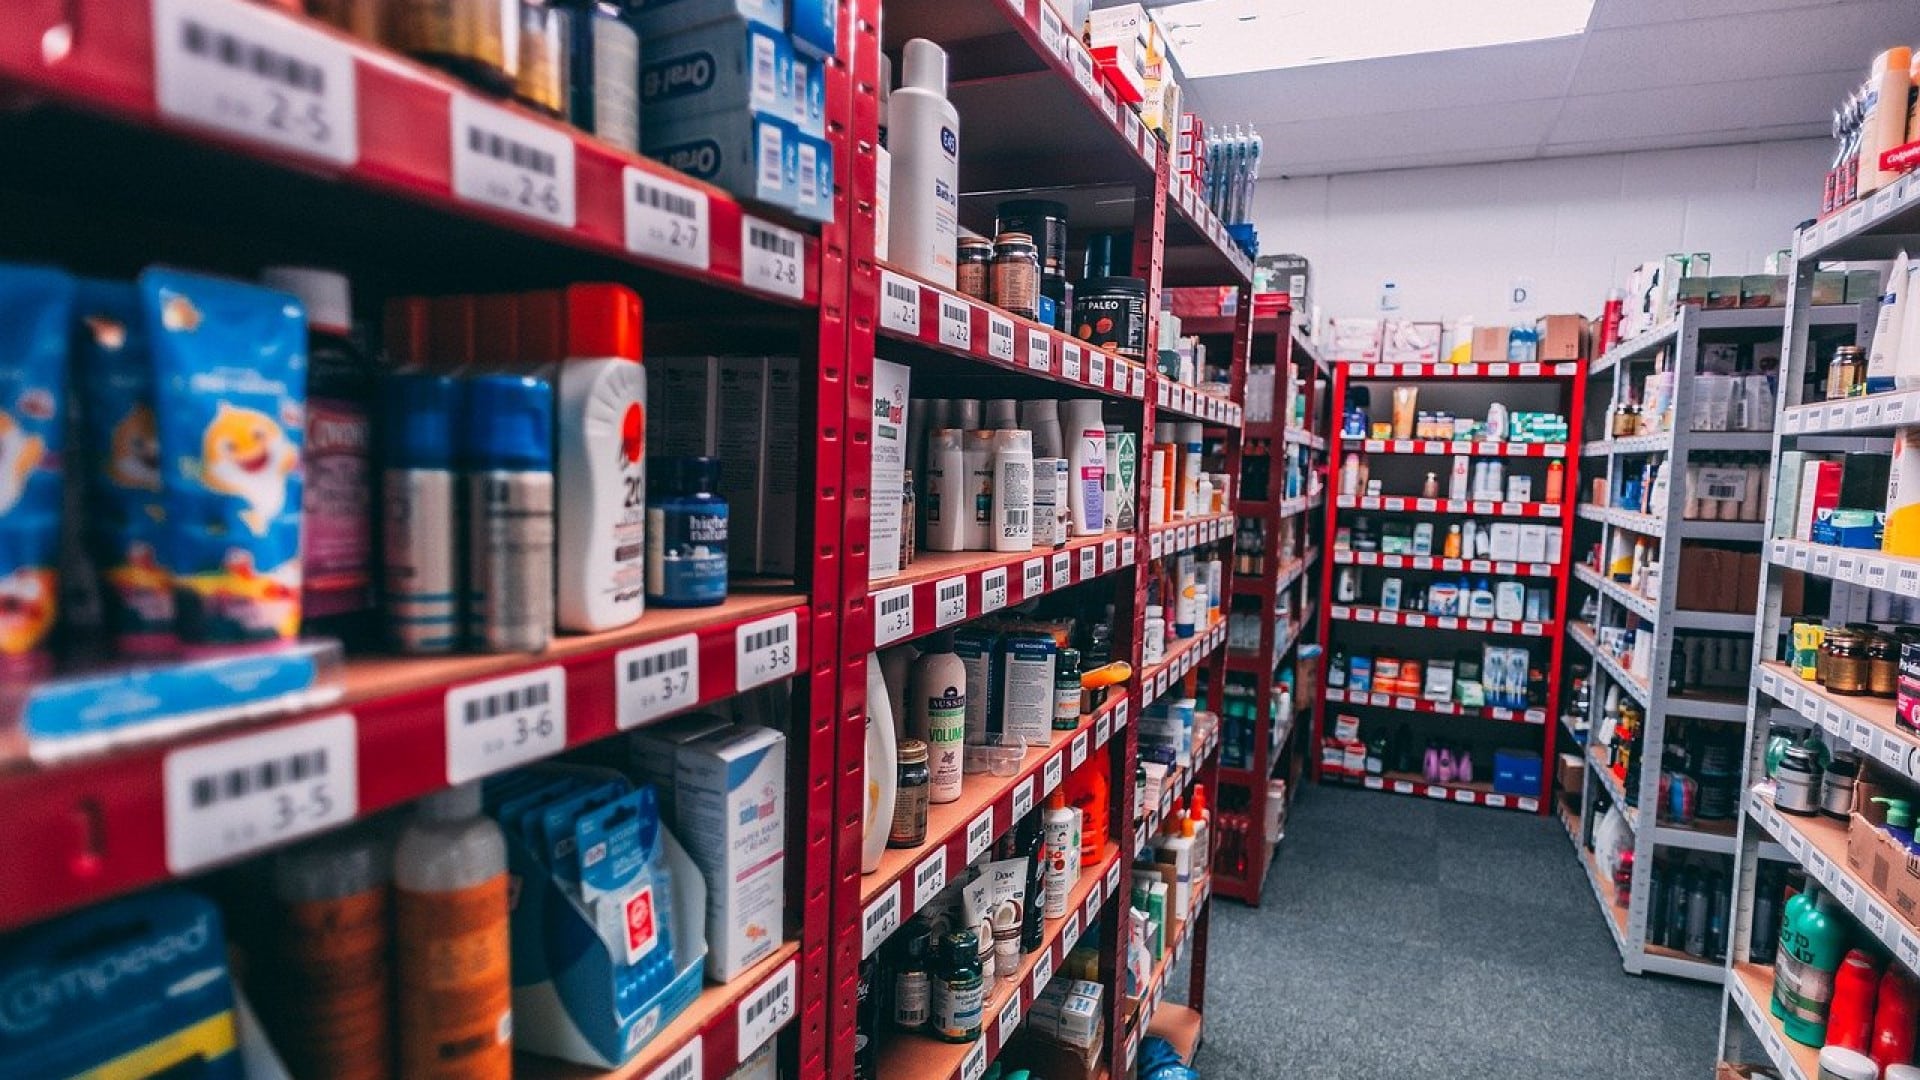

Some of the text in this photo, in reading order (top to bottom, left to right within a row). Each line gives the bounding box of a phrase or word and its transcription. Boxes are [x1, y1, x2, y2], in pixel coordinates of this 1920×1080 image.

[264, 93, 331, 143] 2-5
[518, 178, 560, 216] 2-6
[670, 221, 699, 250] 2-7
[774, 257, 797, 285] 2-8
[1087, 301, 1119, 310] PALEO
[1513, 287, 1527, 303] D
[902, 305, 916, 325] 2-1
[956, 324, 968, 341] 2-2
[953, 598, 964, 616] 3-2
[995, 588, 1005, 604] 3-3
[896, 611, 910, 630] 3-1
[769, 645, 791, 670] 3-8
[661, 671, 690, 700] 3-7
[514, 711, 554, 747] 3-6
[274, 784, 335, 831] 3-5
[929, 872, 943, 890] 4-2
[994, 871, 1015, 881] Dove
[881, 911, 896, 933] 4-1
[768, 995, 790, 1024] 4-8
